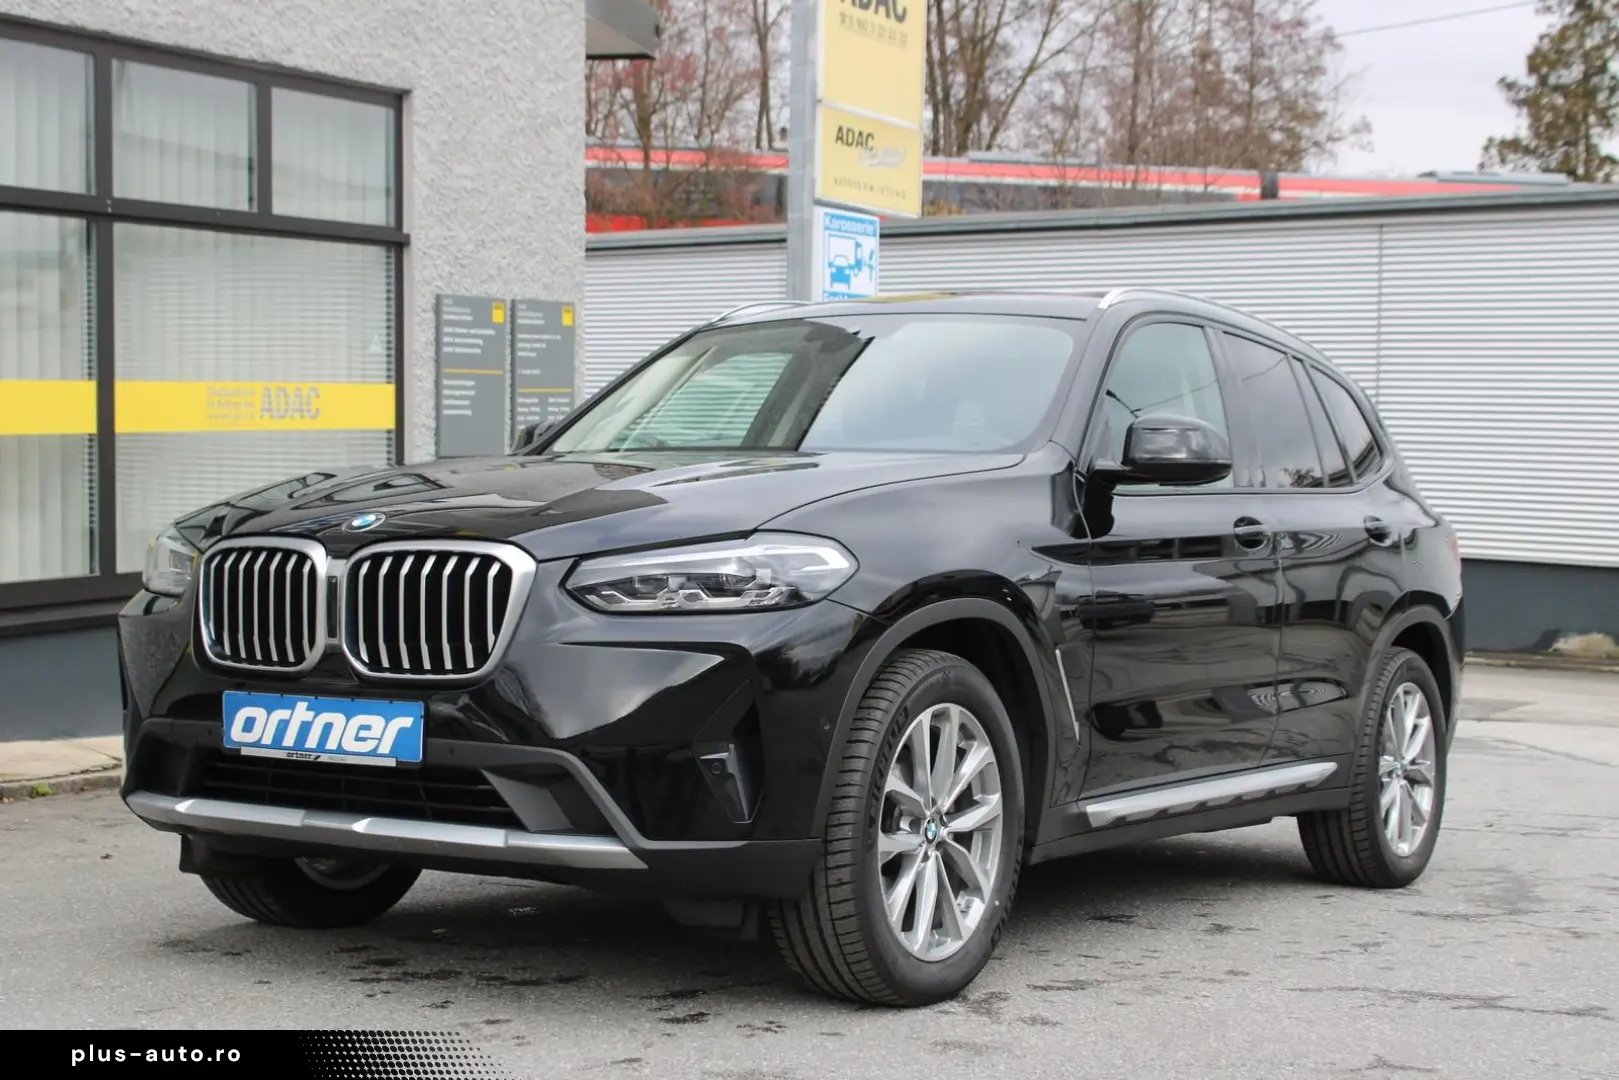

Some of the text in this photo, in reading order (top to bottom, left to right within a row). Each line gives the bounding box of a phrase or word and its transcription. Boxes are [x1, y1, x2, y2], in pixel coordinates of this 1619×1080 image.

[835, 125, 875, 152] ADAC
[260, 386, 320, 420] ADAC
[230, 701, 414, 754] ortner
